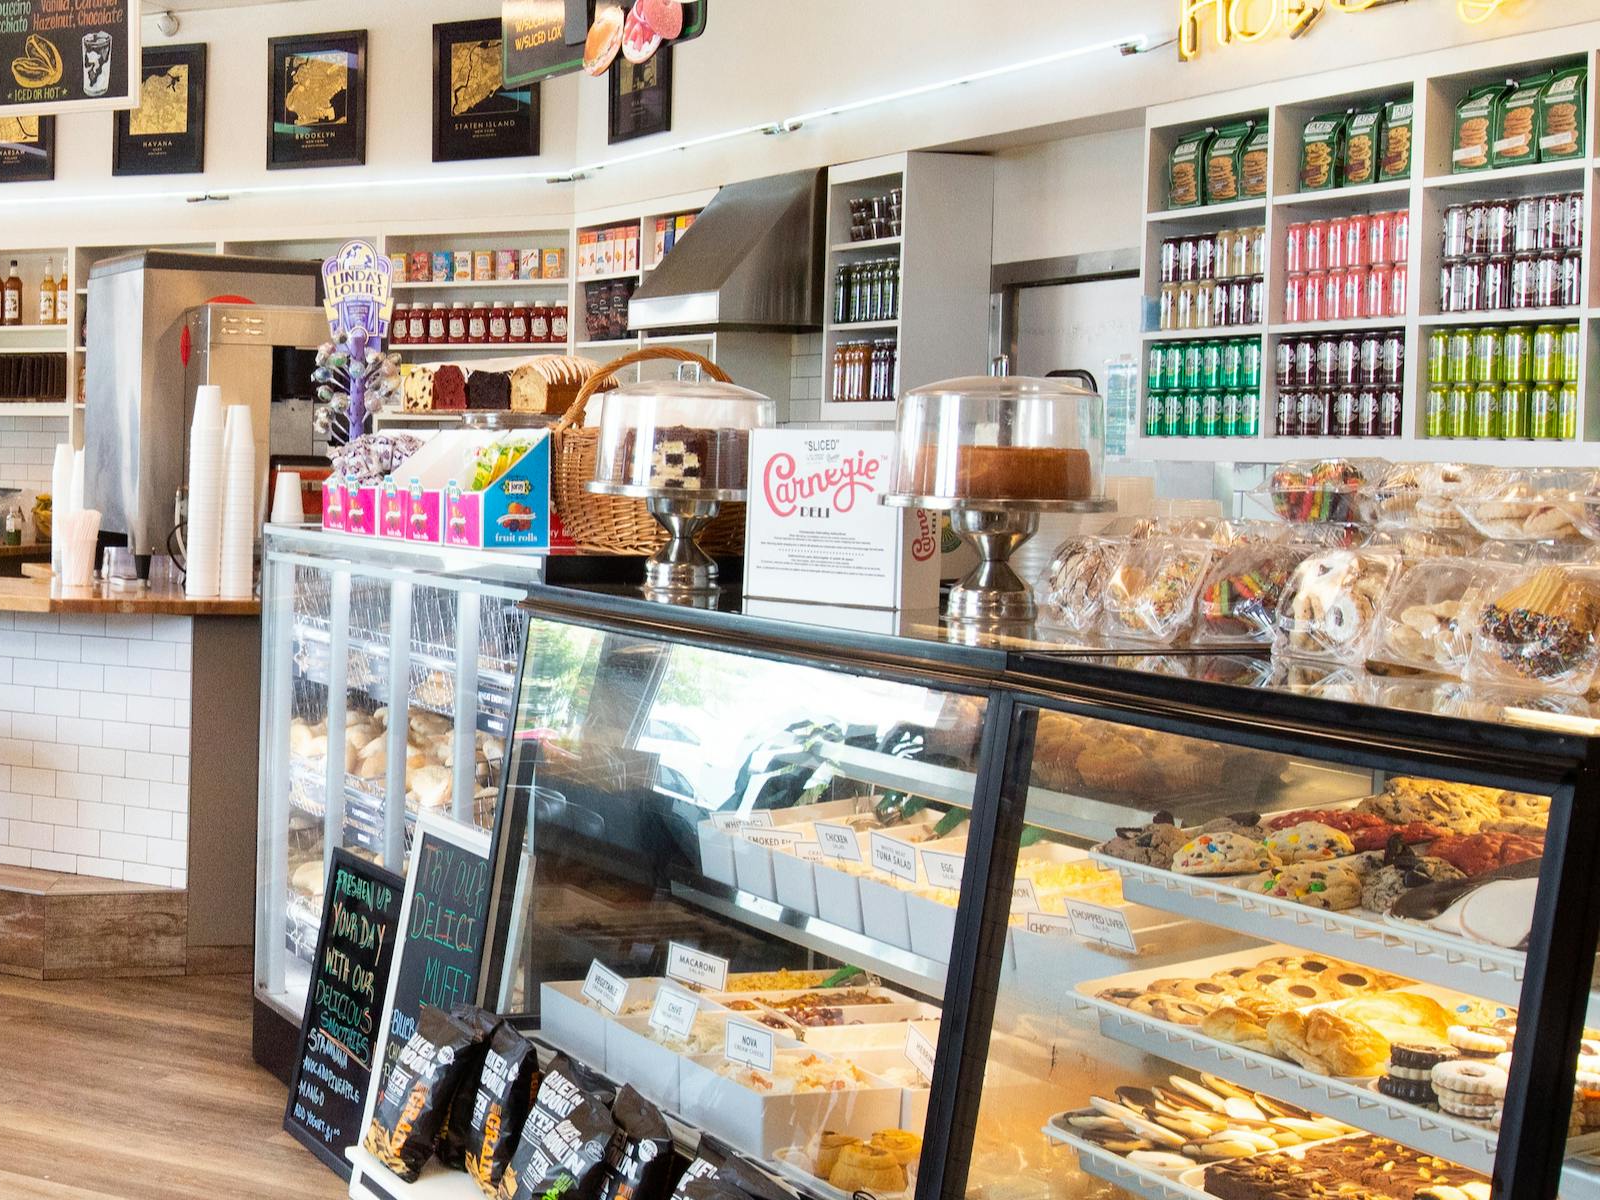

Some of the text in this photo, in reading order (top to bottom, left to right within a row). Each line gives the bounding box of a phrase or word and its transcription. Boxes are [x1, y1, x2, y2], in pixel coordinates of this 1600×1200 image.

[78, 9, 123, 25] Chocolate
[547, 25, 563, 40] LOX
[15, 87, 61, 101] ICED OR HOT
[454, 120, 515, 130] STATEN ISLAND
[296, 131, 336, 139] BROOKLYN
[143, 140, 173, 148] HAVANA
[332, 271, 382, 288] LINDA'S
[335, 284, 382, 298] LOLLIES
[764, 449, 880, 518] Carnegie
[800, 506, 830, 519] DELI
[495, 532, 538, 543] fruit rolls
[825, 832, 848, 844] CHICKEN
[876, 849, 912, 871] TUNA SALAD
[941, 863, 955, 874] EGG
[423, 843, 488, 918] TRY OUR
[334, 869, 391, 912] FRESHEN UP
[411, 892, 477, 953] DELICI
[1071, 908, 1124, 930] CHOPPED LIVER
[332, 901, 386, 967] YOUR DAY
[679, 954, 716, 974] MACARONI
[325, 946, 374, 1002] WITH OUR
[422, 957, 472, 1009] MUFFI
[594, 975, 619, 996] VEGETABLE
[315, 979, 372, 1034] DELICIOUS
[667, 1003, 683, 1016] CHIVE
[320, 1011, 369, 1064] SMOOTHIES
[742, 1034, 758, 1049] NOVA
[294, 1102, 305, 1120] ADD
